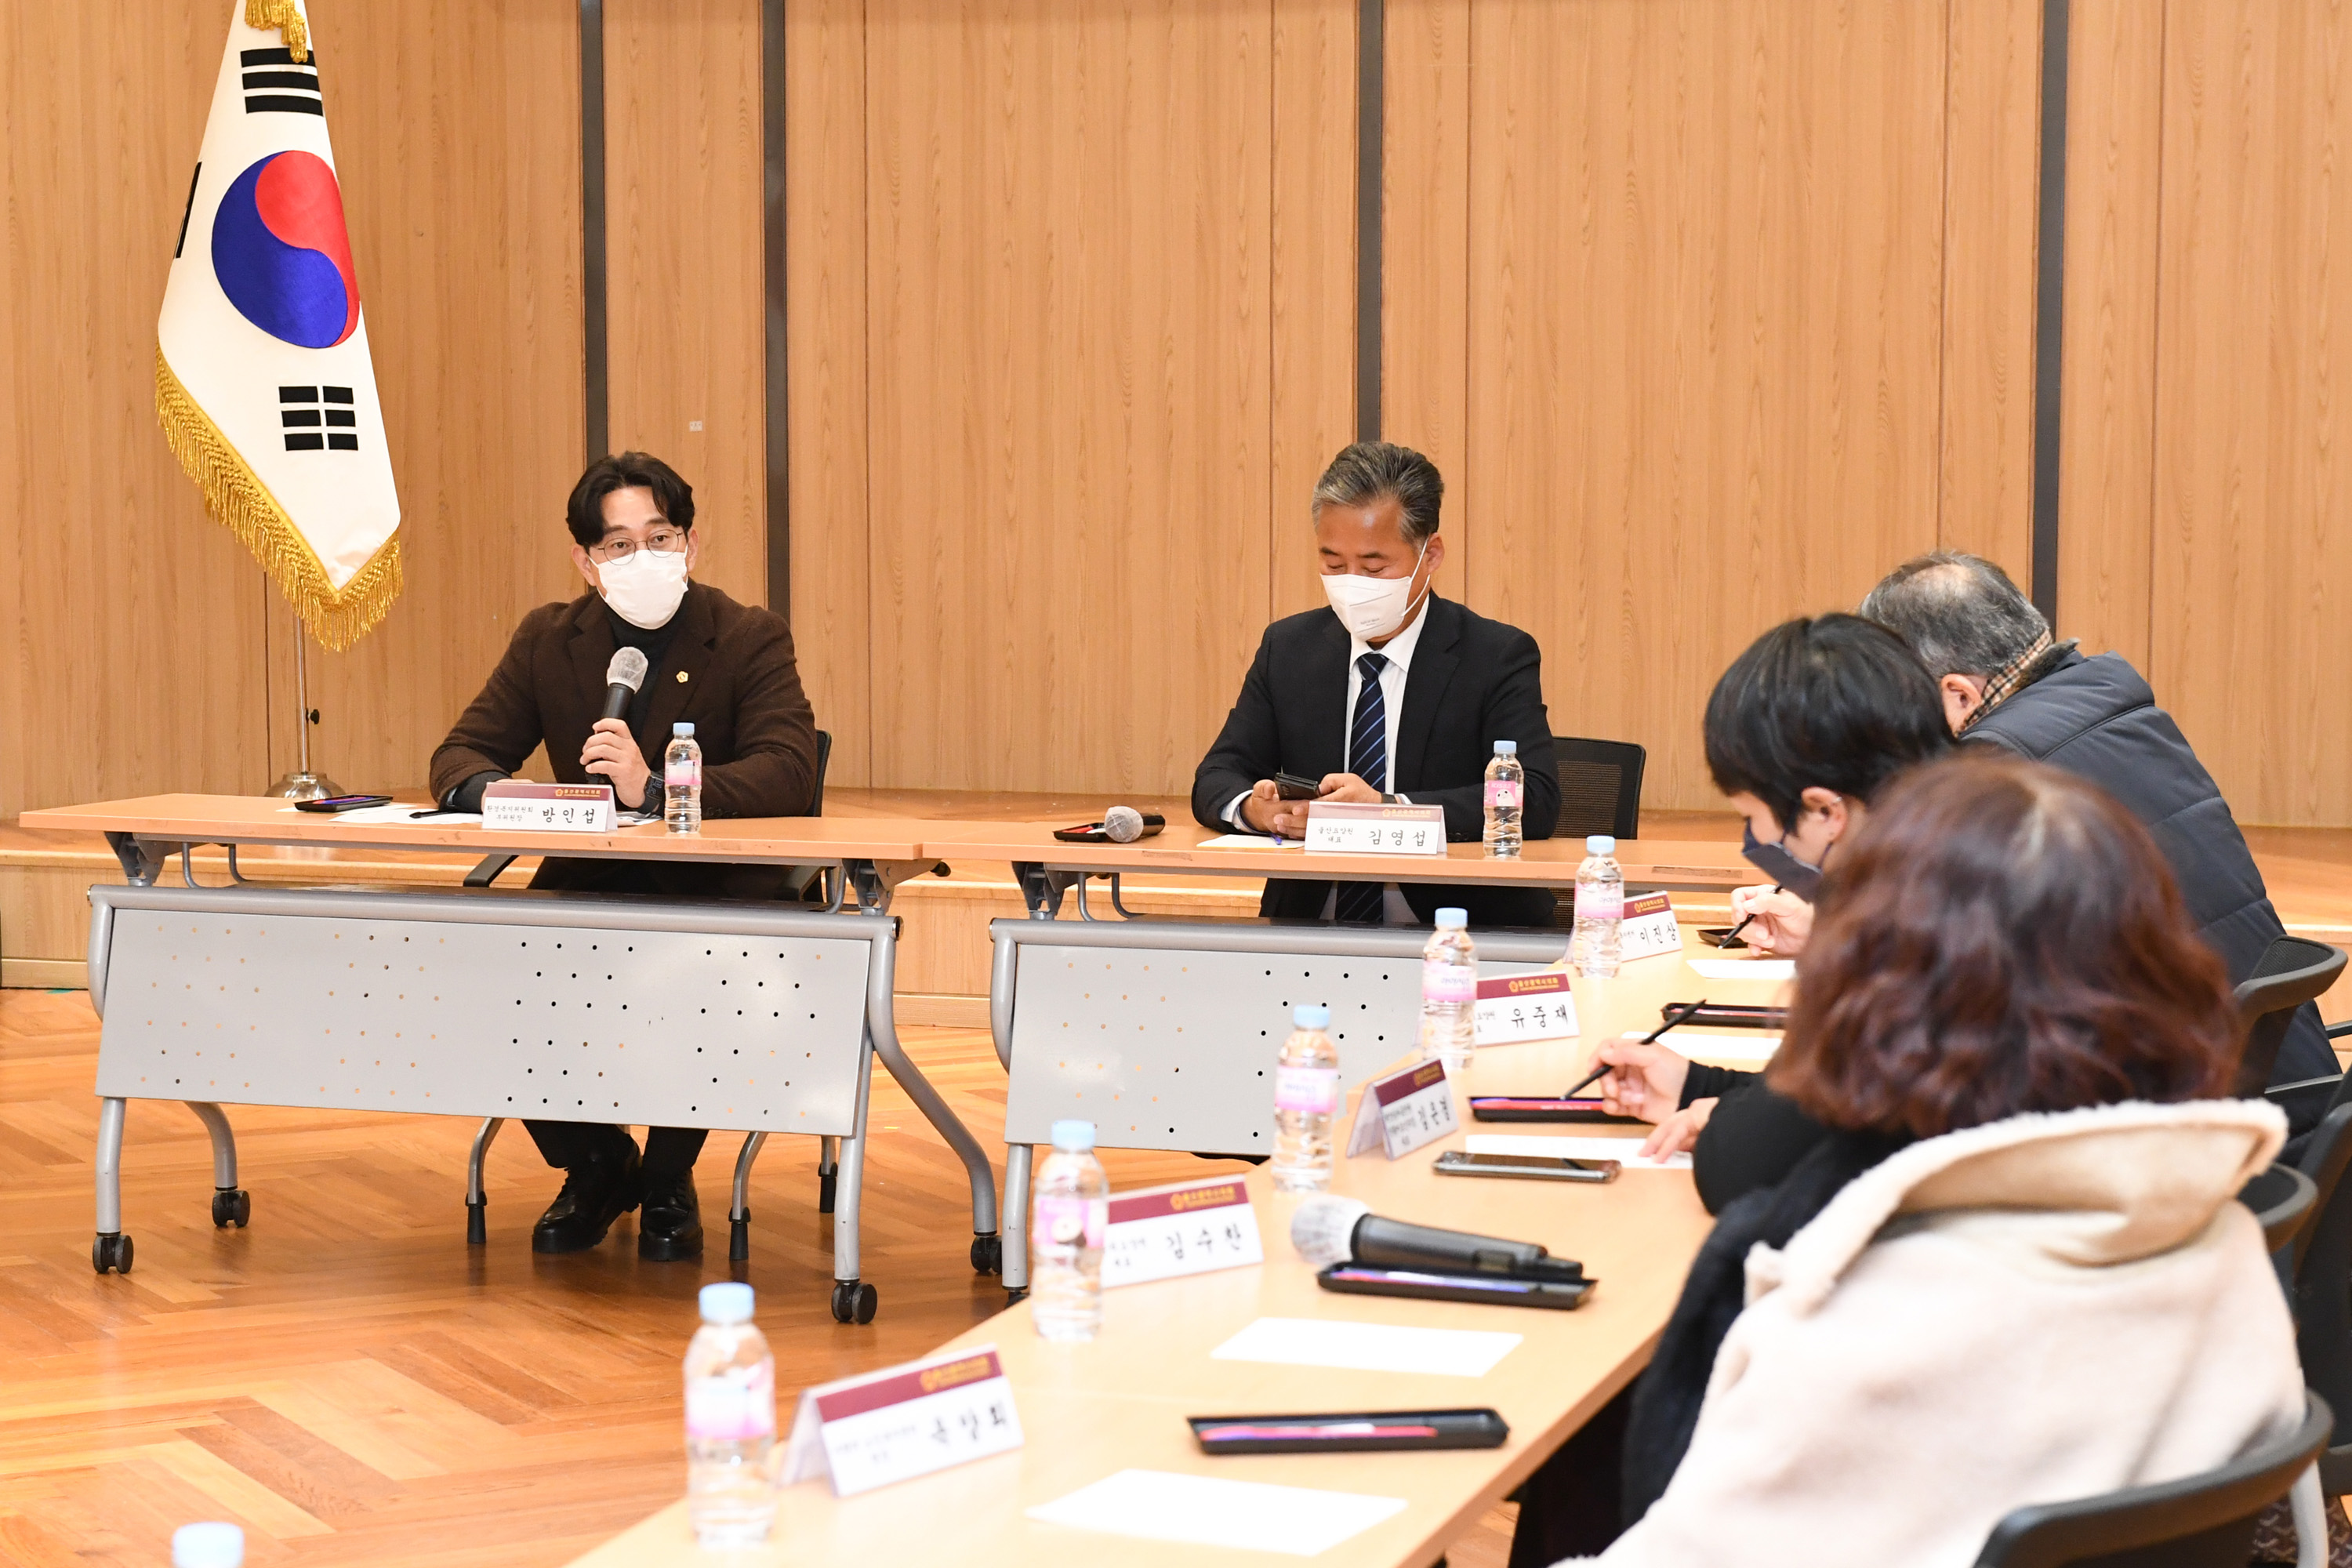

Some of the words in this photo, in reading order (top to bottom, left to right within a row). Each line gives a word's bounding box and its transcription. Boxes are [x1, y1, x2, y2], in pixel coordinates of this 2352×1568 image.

[542, 807, 595, 824] 방인섭
[1369, 829, 1426, 847] 김영섭
[1639, 922, 1676, 945] 이진상
[1511, 1004, 1569, 1029] 유중재
